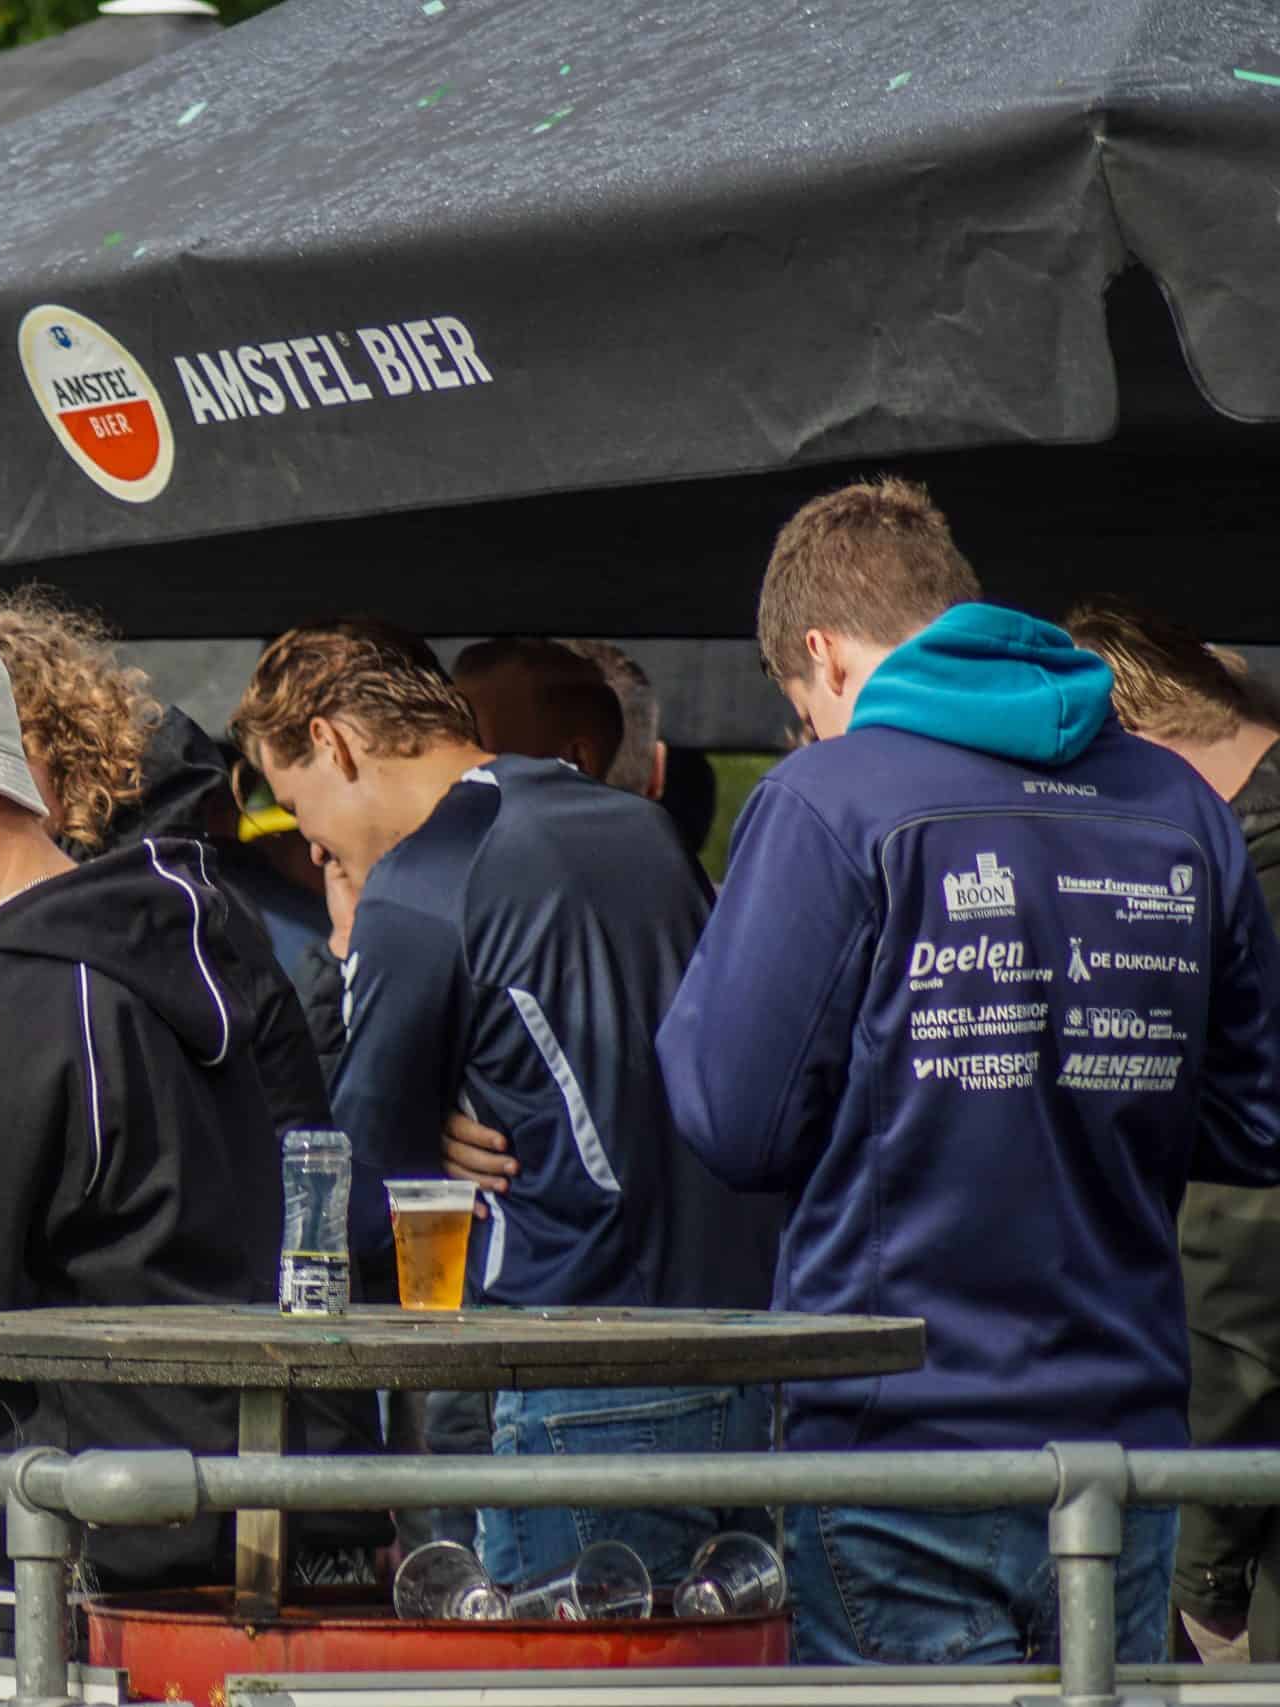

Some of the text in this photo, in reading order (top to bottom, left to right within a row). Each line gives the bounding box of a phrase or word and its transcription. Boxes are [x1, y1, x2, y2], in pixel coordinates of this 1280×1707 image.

[173, 315, 493, 425] AMSTEL BIER
[52, 367, 137, 409] AMSTEL
[88, 412, 132, 440] BIER
[1023, 781, 1097, 797] STANNO
[956, 885, 1006, 905] BOON
[909, 935, 1024, 977] Deelen
[1090, 951, 1111, 969] DE
[1115, 952, 1177, 972] DUKDALF
[911, 1006, 976, 1027] MARCEL
[1093, 1016, 1147, 1040] DUO
[1062, 1053, 1184, 1078] MENSINK
